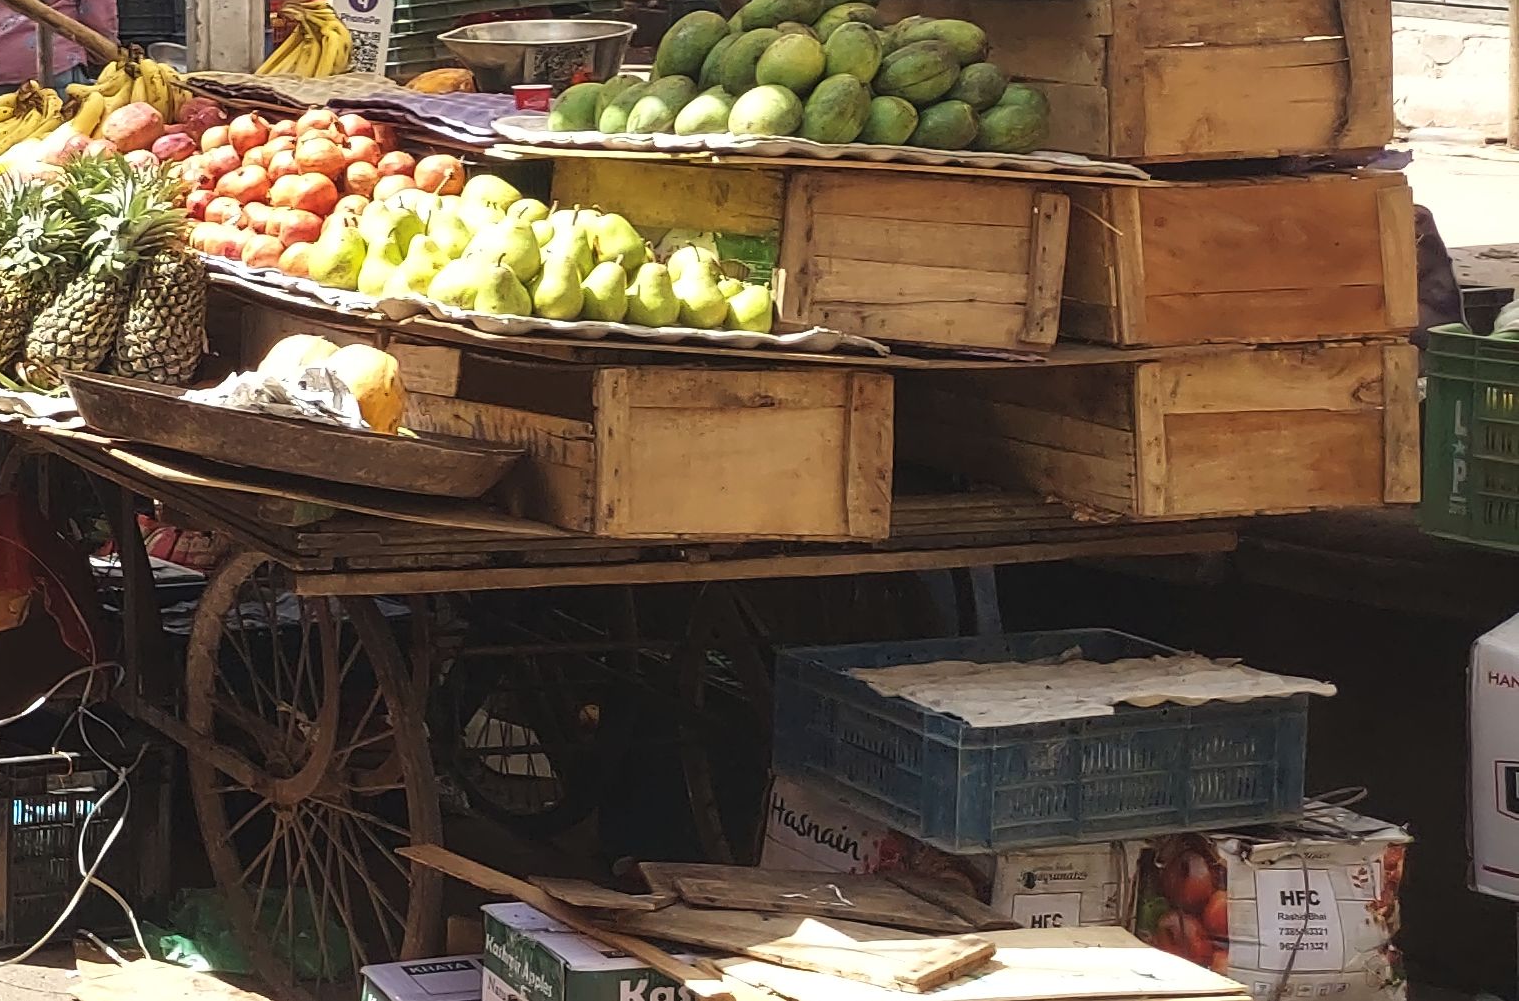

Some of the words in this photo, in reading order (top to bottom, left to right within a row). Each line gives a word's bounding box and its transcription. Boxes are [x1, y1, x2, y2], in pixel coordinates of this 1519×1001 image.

[771, 792, 861, 862] Hasnain
[1280, 890, 1321, 906] HFC
[408, 961, 470, 975] KHATA
